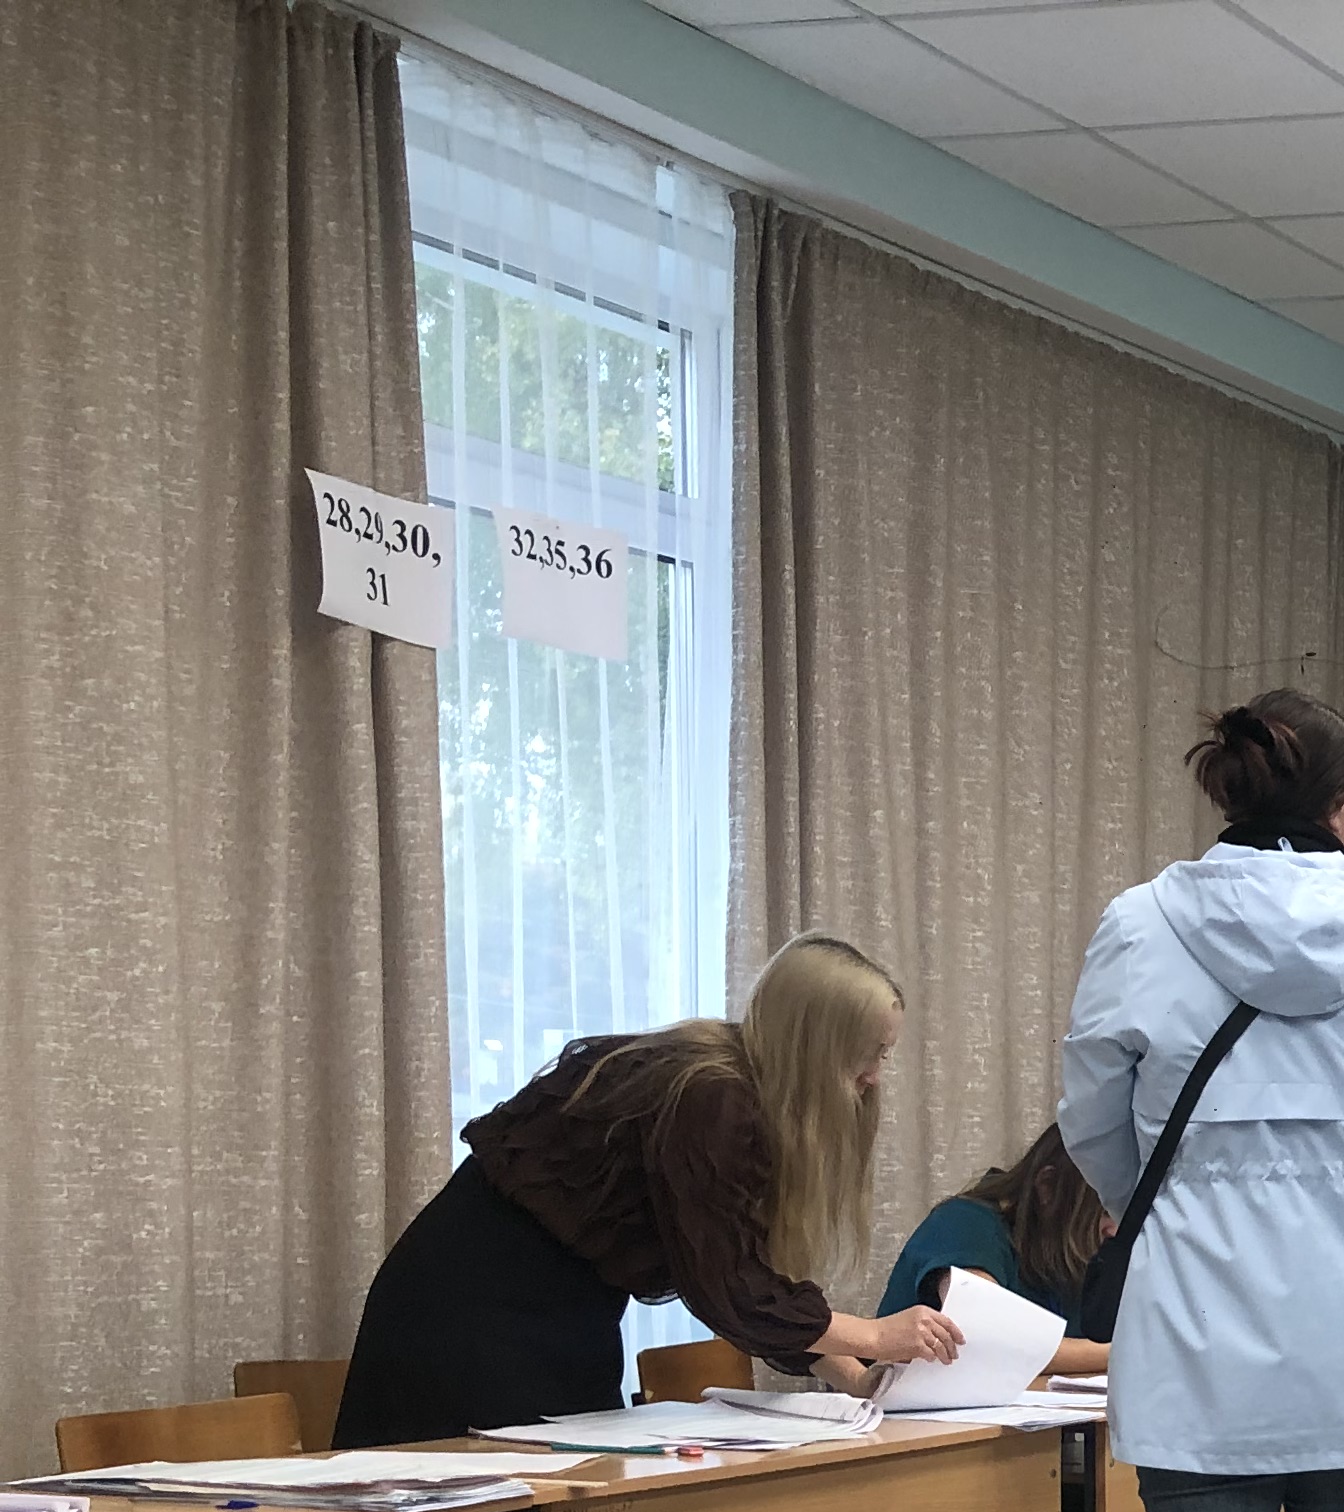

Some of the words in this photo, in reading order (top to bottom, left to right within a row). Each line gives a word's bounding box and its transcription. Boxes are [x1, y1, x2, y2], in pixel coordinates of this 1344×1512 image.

[322, 492, 442, 568] 28,29,30,
[509, 525, 613, 580] 32,35,36
[366, 567, 390, 606] 31
